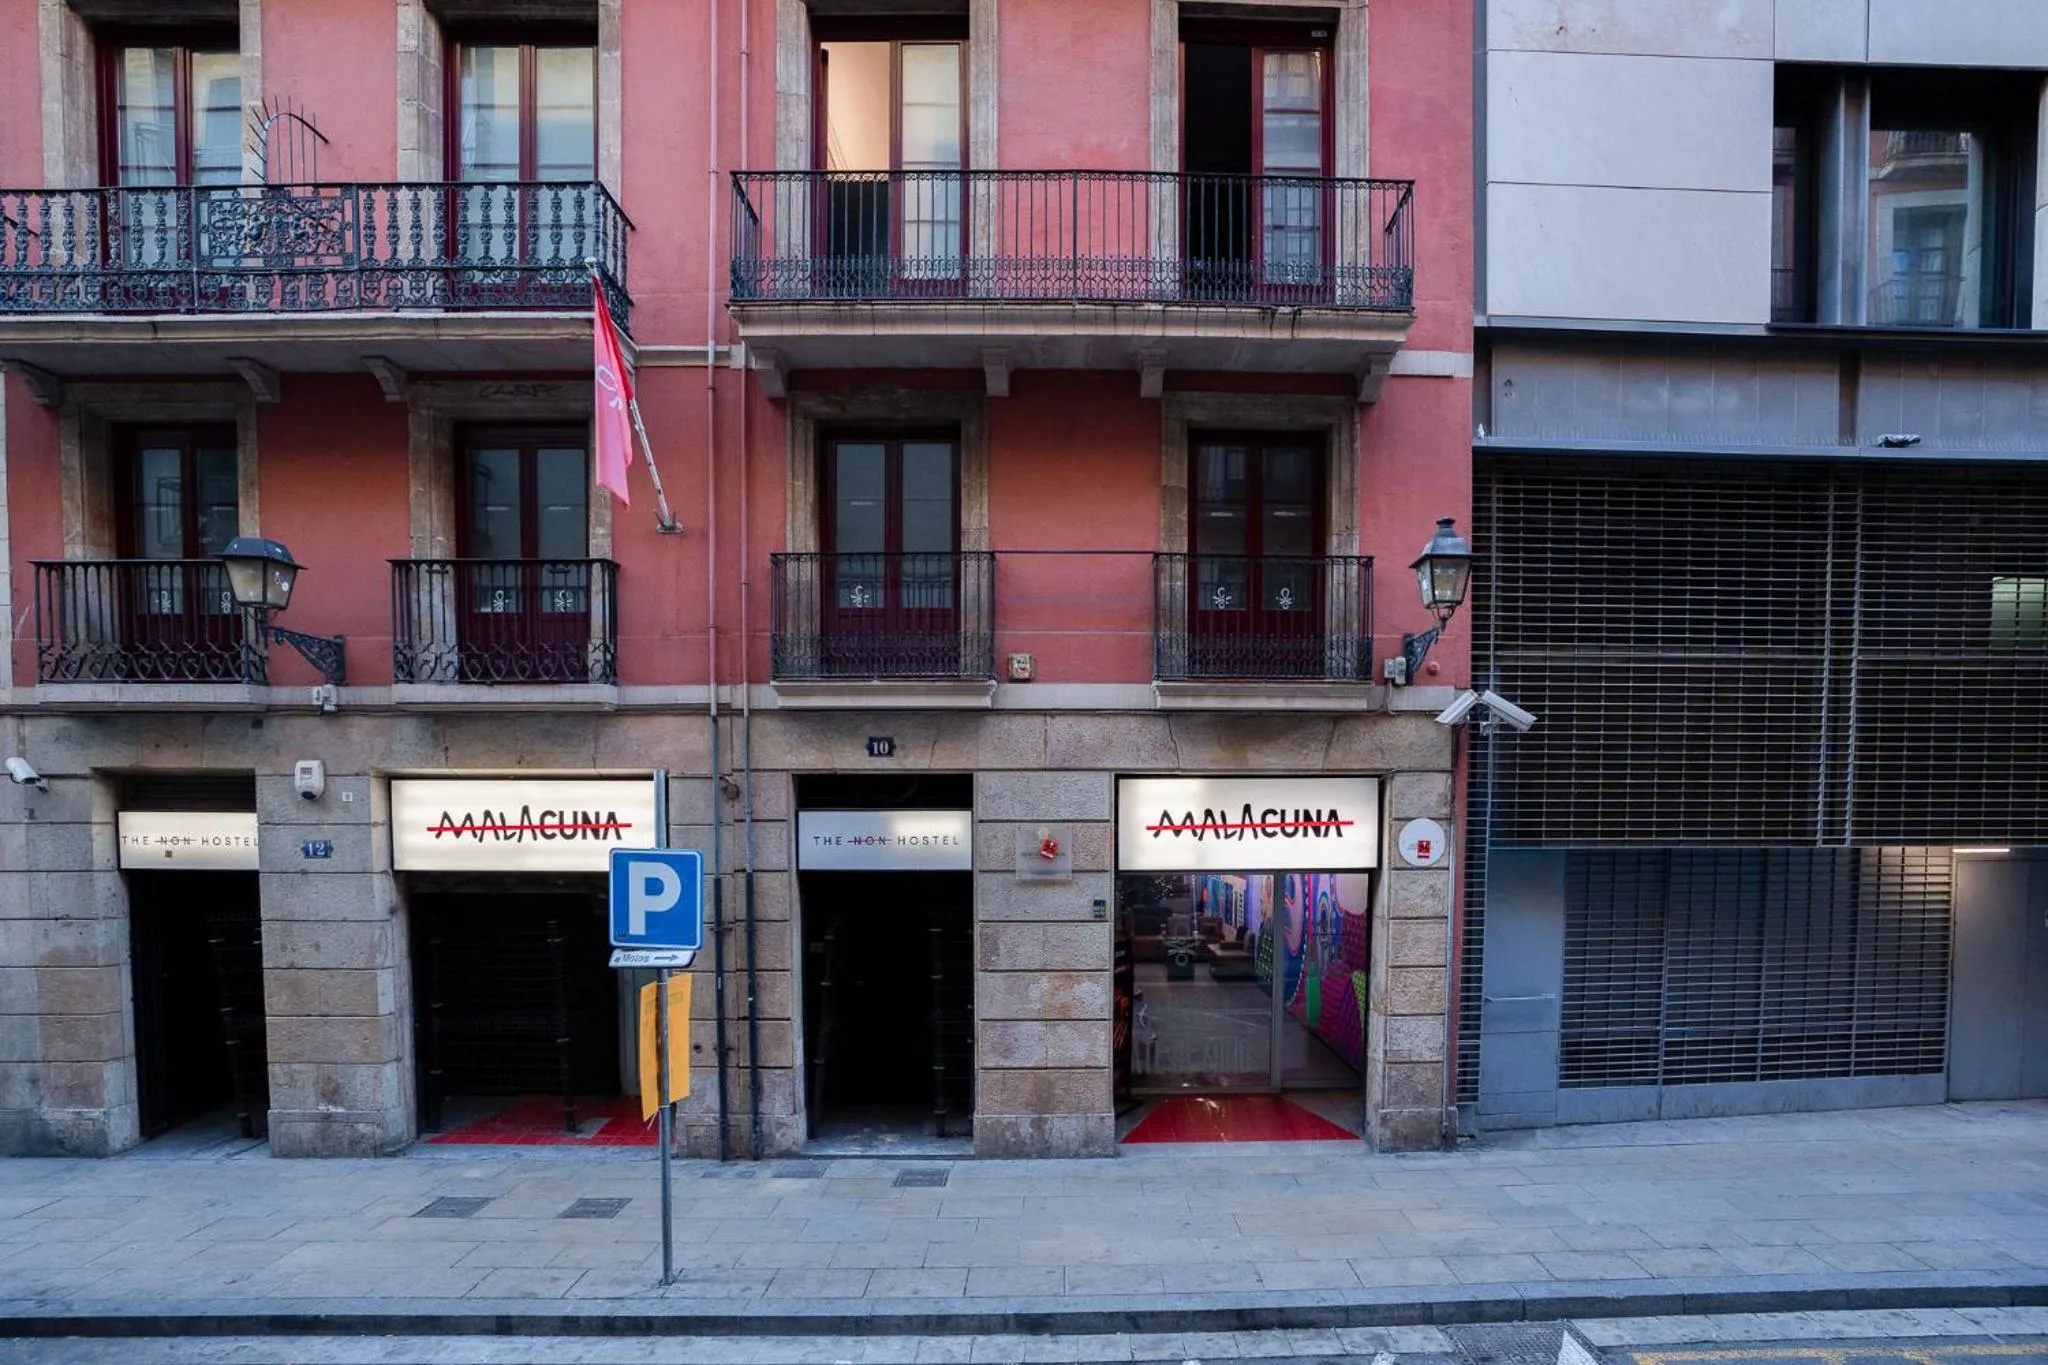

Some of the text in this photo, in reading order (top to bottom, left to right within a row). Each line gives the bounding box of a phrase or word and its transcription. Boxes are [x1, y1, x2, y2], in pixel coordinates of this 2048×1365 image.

[871, 740, 890, 755] 10
[435, 804, 622, 843] MALACUNA
[1153, 803, 1344, 842] MALACUNA
[121, 836, 149, 846] THE
[201, 836, 259, 847] HOSTEL
[813, 836, 843, 846] THE
[897, 836, 960, 846] HOSTEL
[308, 842, 326, 856] 12
[628, 861, 682, 935] P
